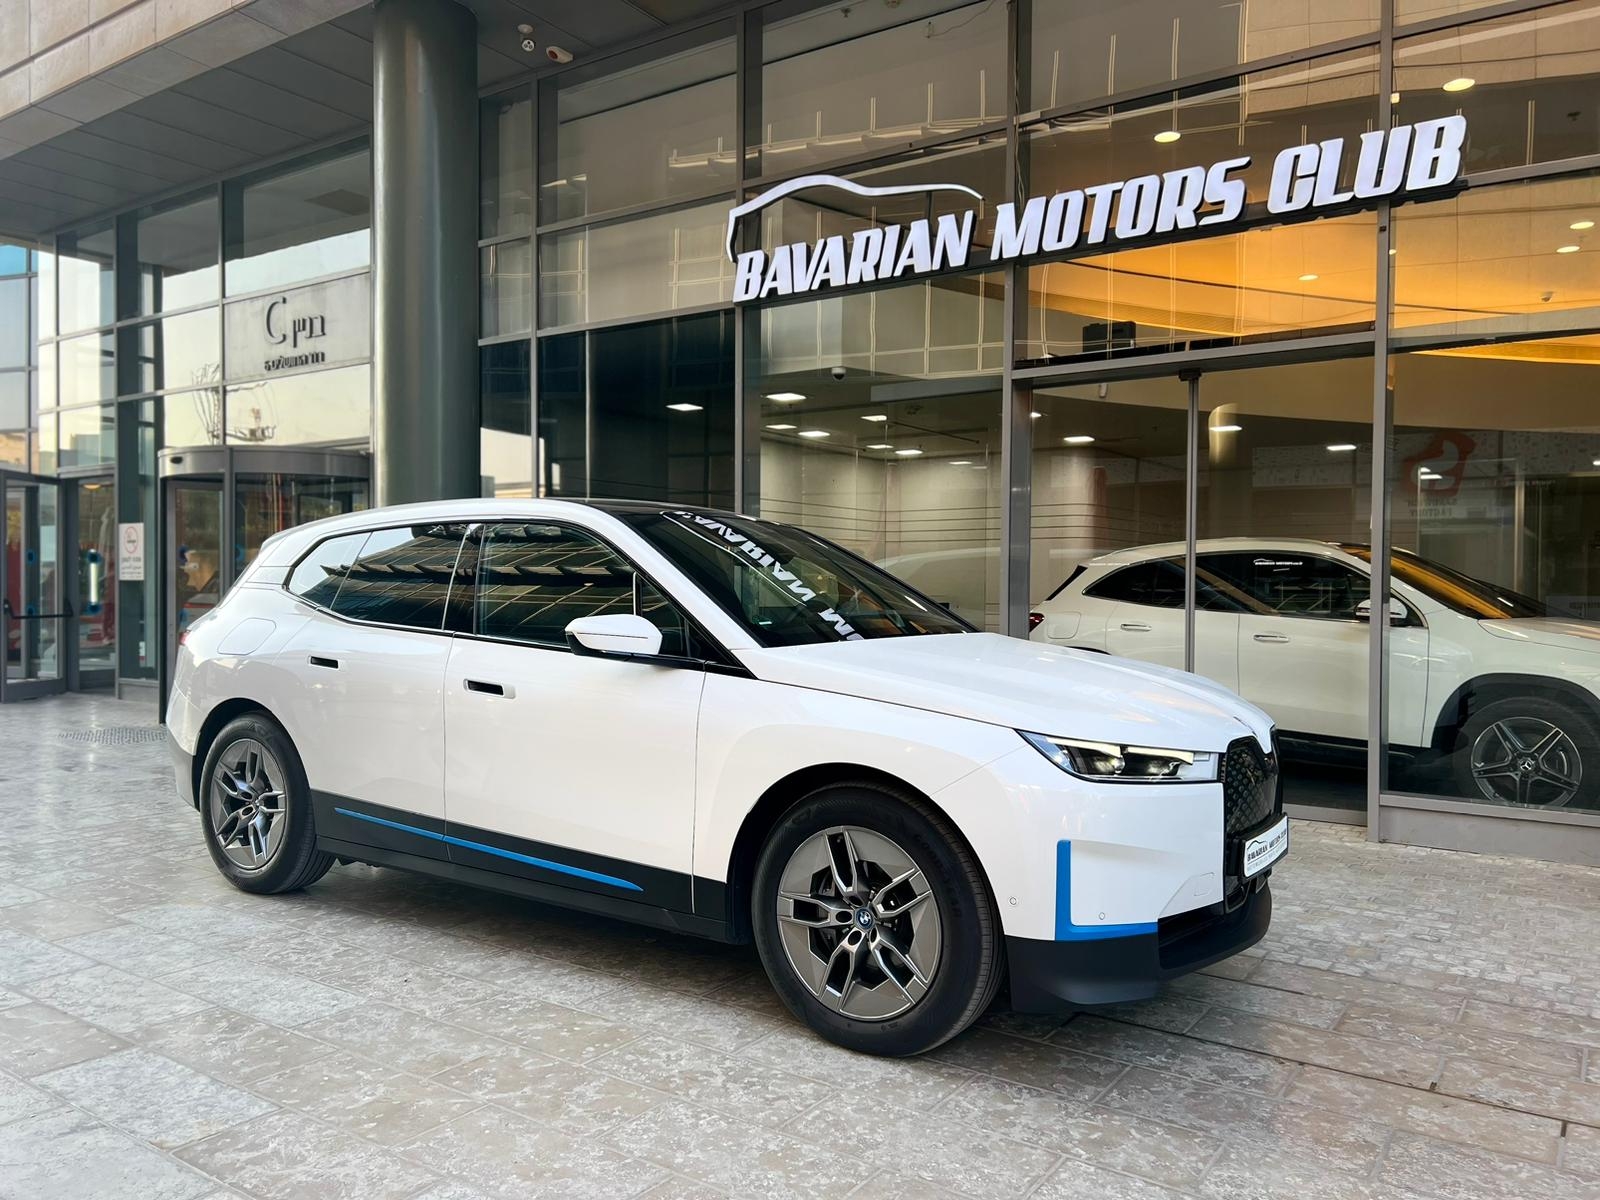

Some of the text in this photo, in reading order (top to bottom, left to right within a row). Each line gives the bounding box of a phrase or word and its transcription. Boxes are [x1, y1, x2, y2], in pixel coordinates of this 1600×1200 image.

[733, 115, 1467, 302] BAVARIAN MOTORS CLUB
[266, 296, 287, 345] C
